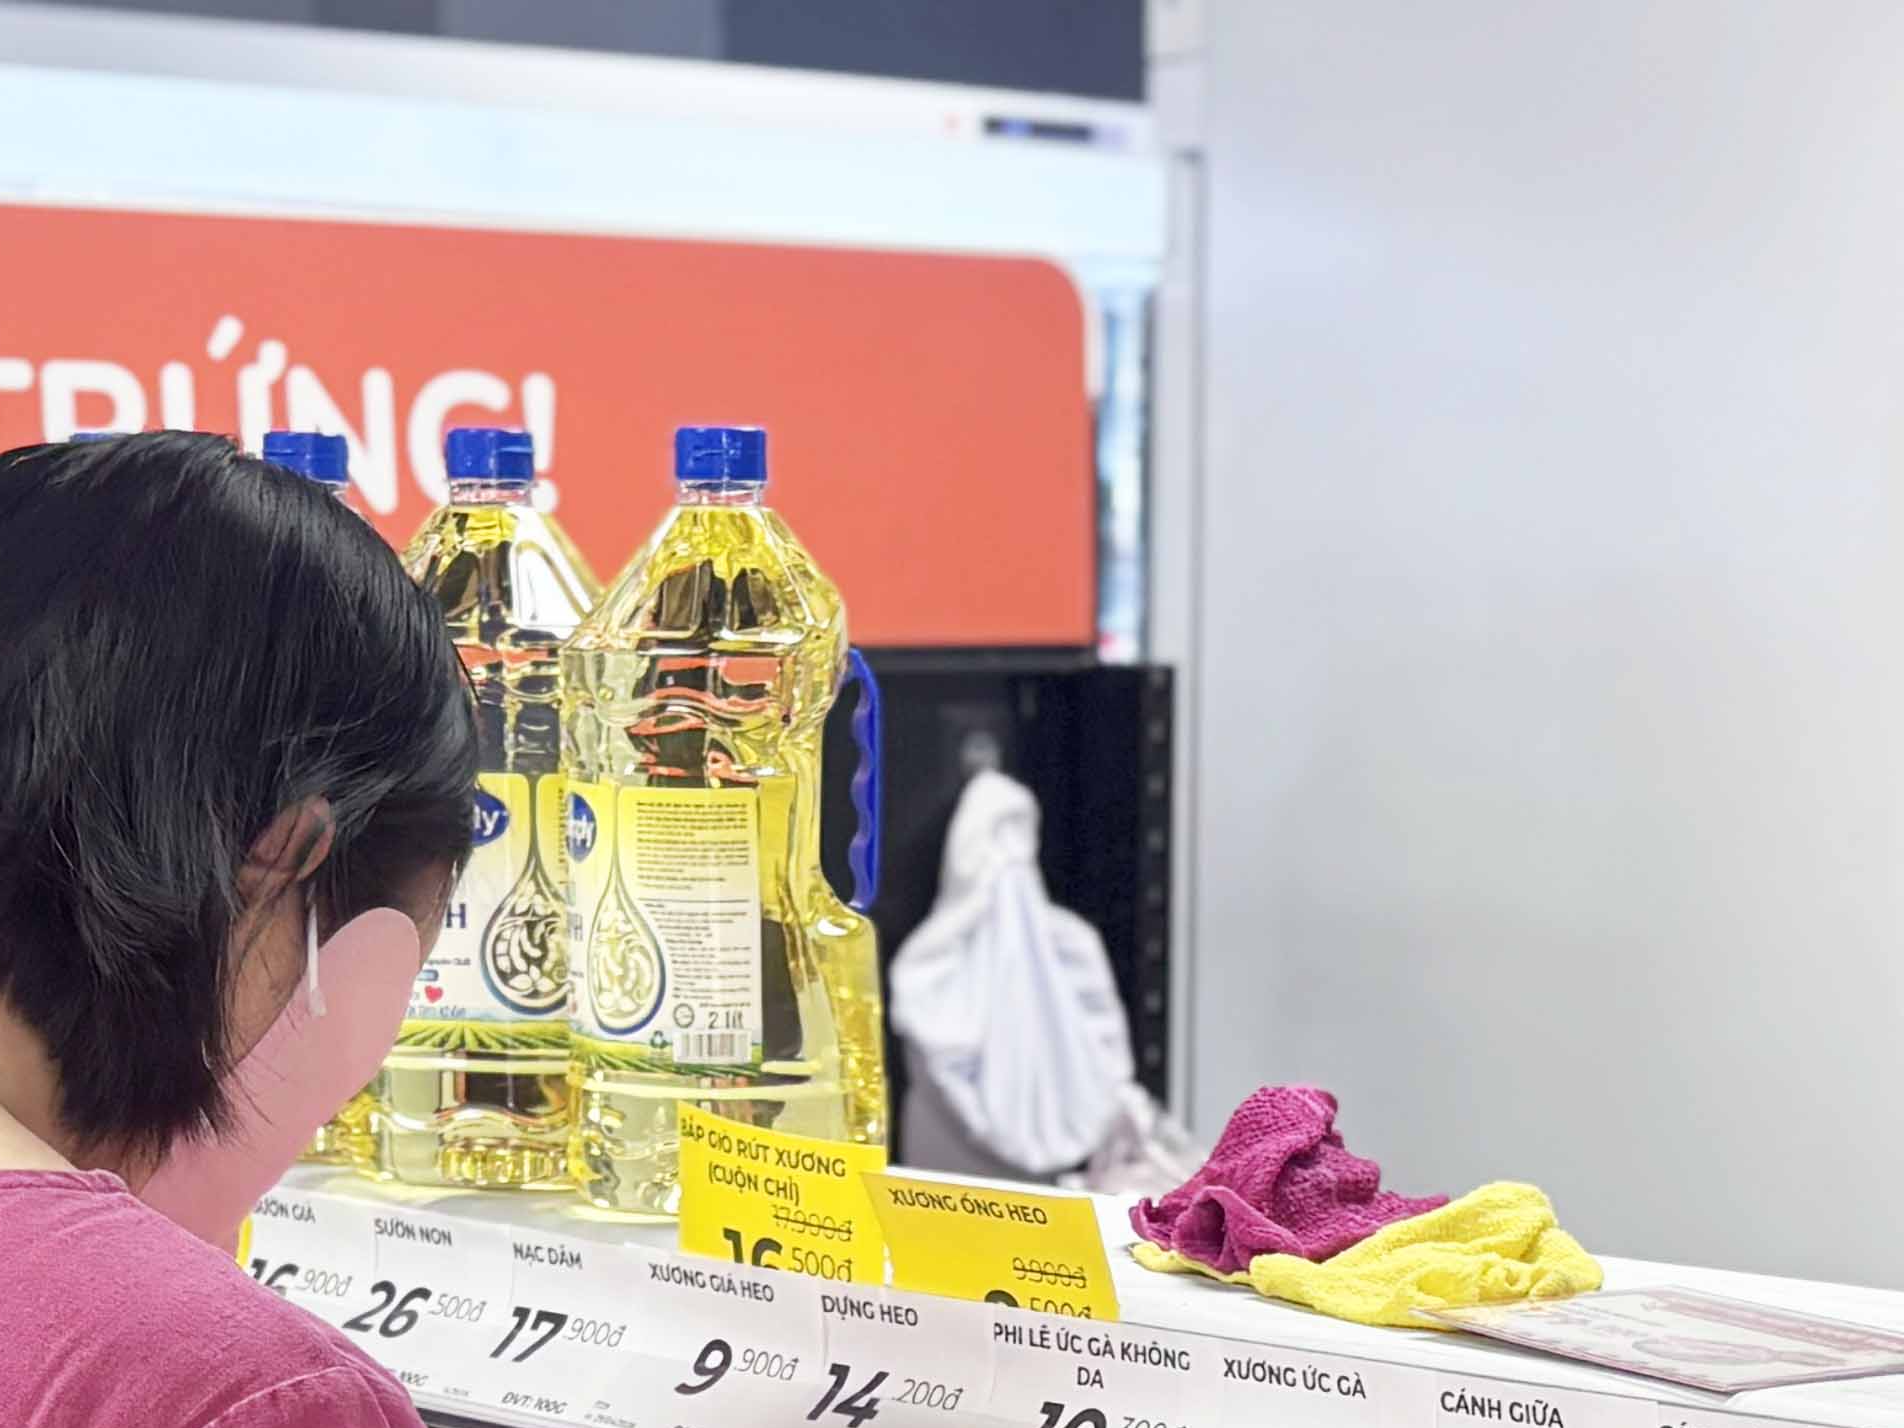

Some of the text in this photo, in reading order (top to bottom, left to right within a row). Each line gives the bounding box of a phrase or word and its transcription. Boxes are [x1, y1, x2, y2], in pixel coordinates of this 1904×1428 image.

[737, 1137, 770, 1163] RÚT
[775, 1147, 846, 1178] XƯƠNG
[888, 1188, 957, 1213] XƯƠNG
[1008, 1204, 1047, 1225] HEO
[419, 1226, 452, 1247] NON
[513, 1242, 545, 1268] NẠC
[648, 1262, 706, 1290] XƯƠNG
[740, 1279, 775, 1303] HEO
[880, 1303, 918, 1327] HEO
[994, 1322, 1191, 1371] PHI LÊ ỨC GÀ KHÔNG
[1077, 1366, 1105, 1389] DA
[1223, 1356, 1367, 1401] XƯƠNG ỨC GÀ
[1440, 1388, 1503, 1422] CÁNH
